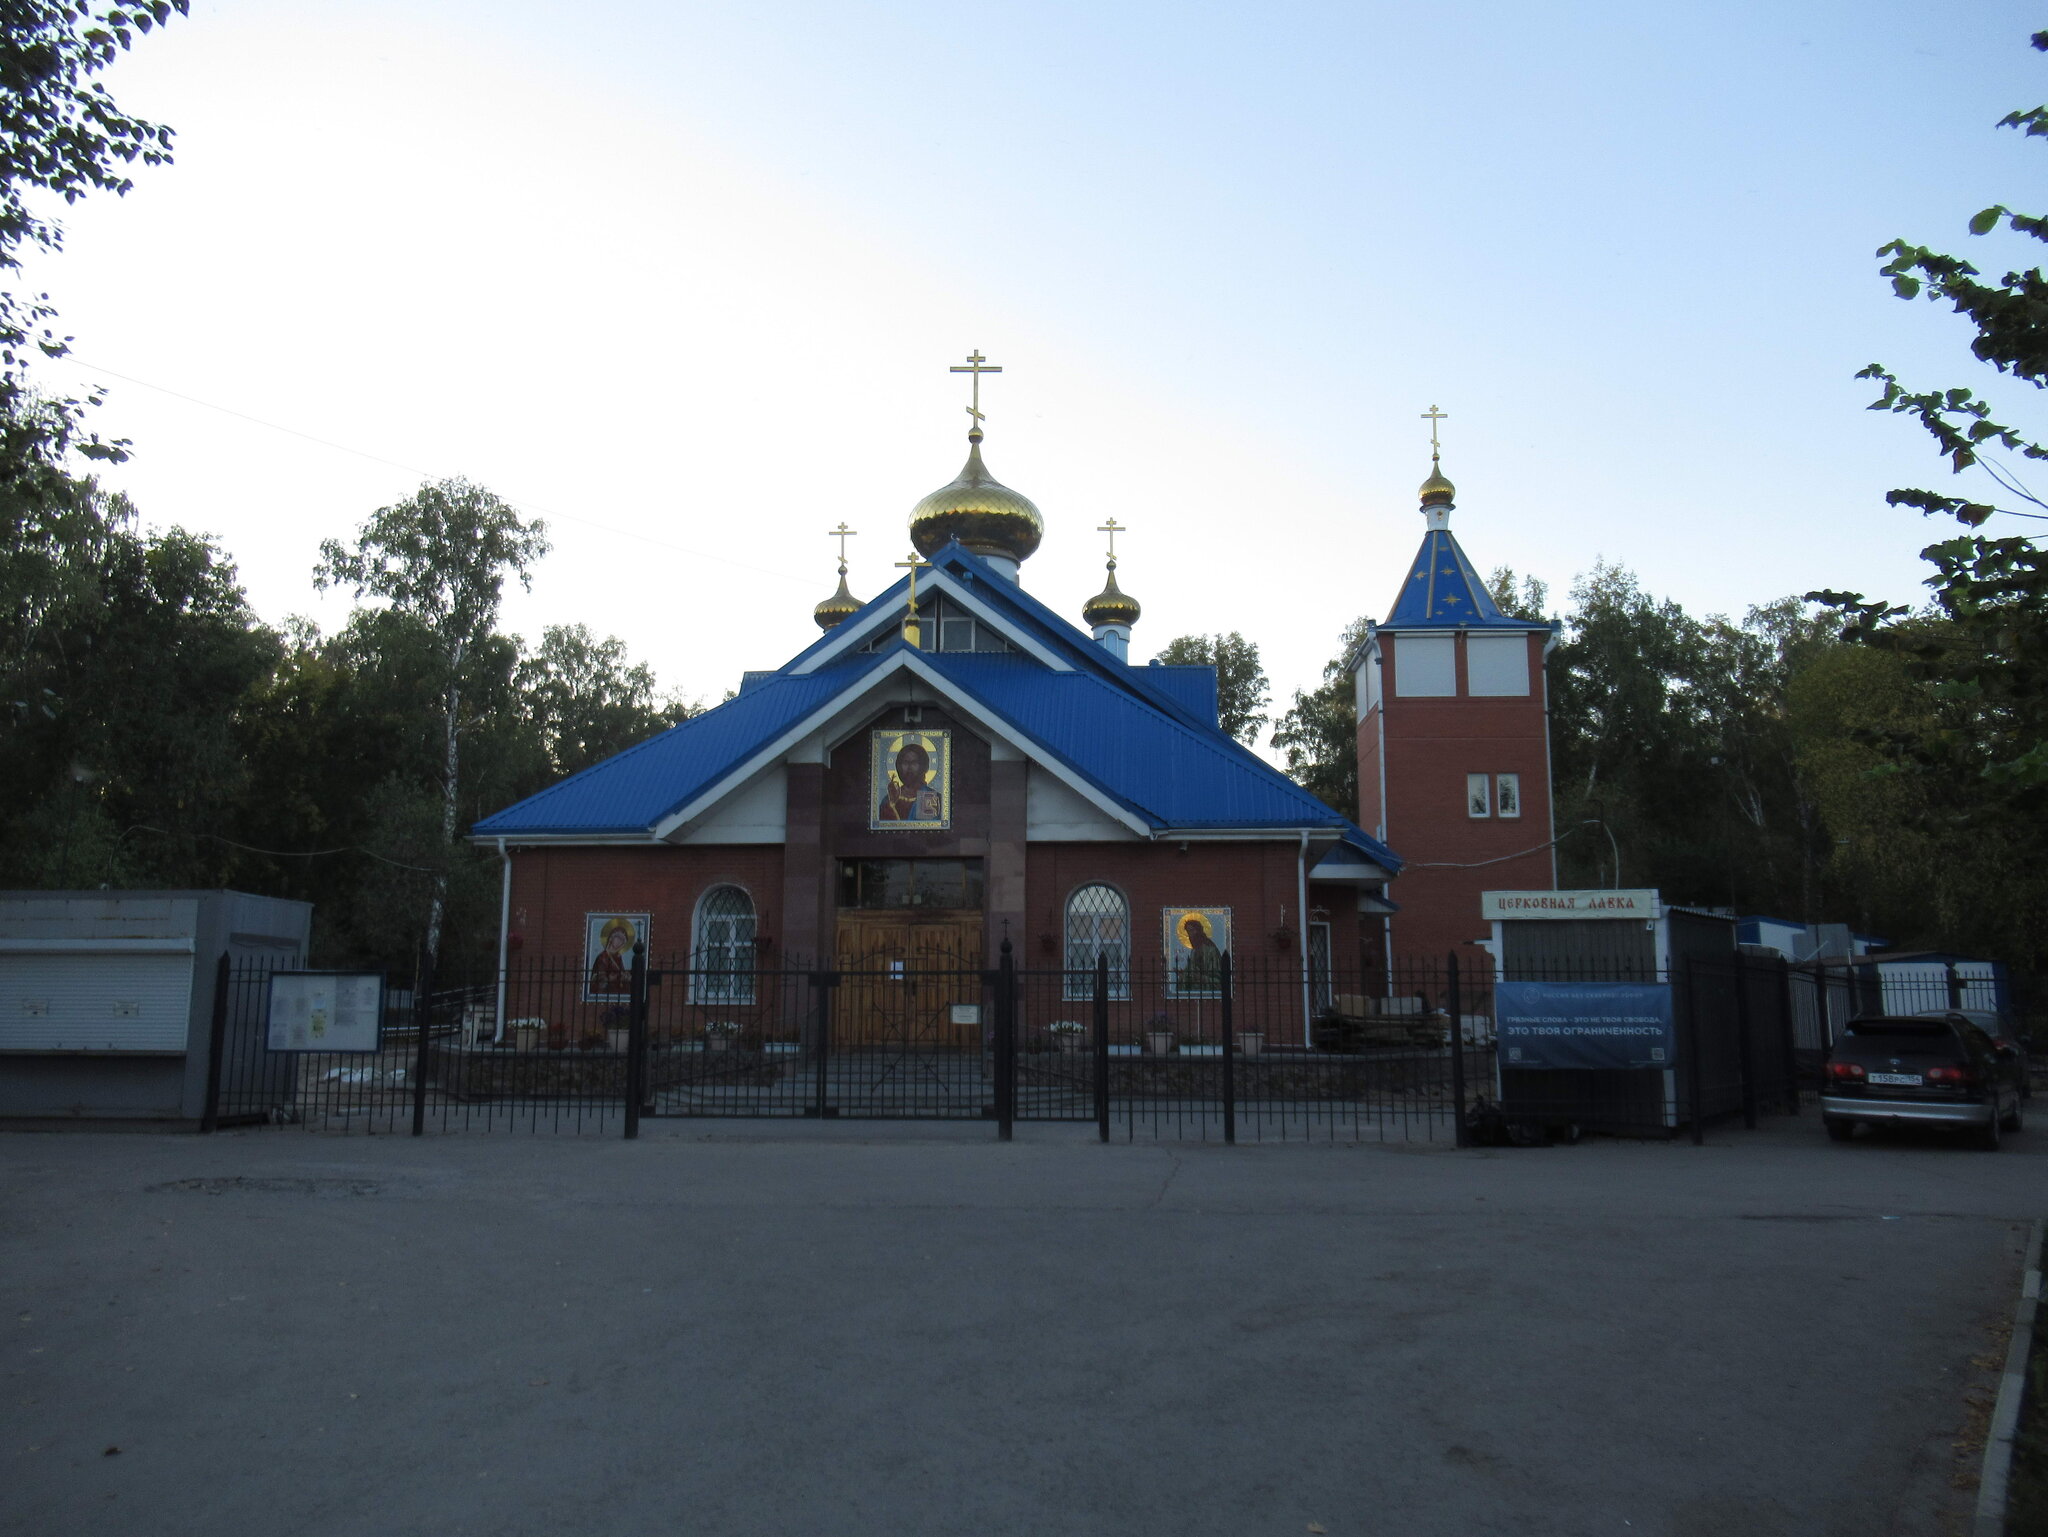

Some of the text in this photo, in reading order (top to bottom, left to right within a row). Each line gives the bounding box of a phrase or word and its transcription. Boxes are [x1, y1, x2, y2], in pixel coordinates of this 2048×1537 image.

[1498, 897, 1635, 910] ЦЕРКОВНАЯ ЛАВКА
[1507, 1026, 1663, 1035] ЭТО ТВОЯ ОГРАНИЧЕННОСТЬ
